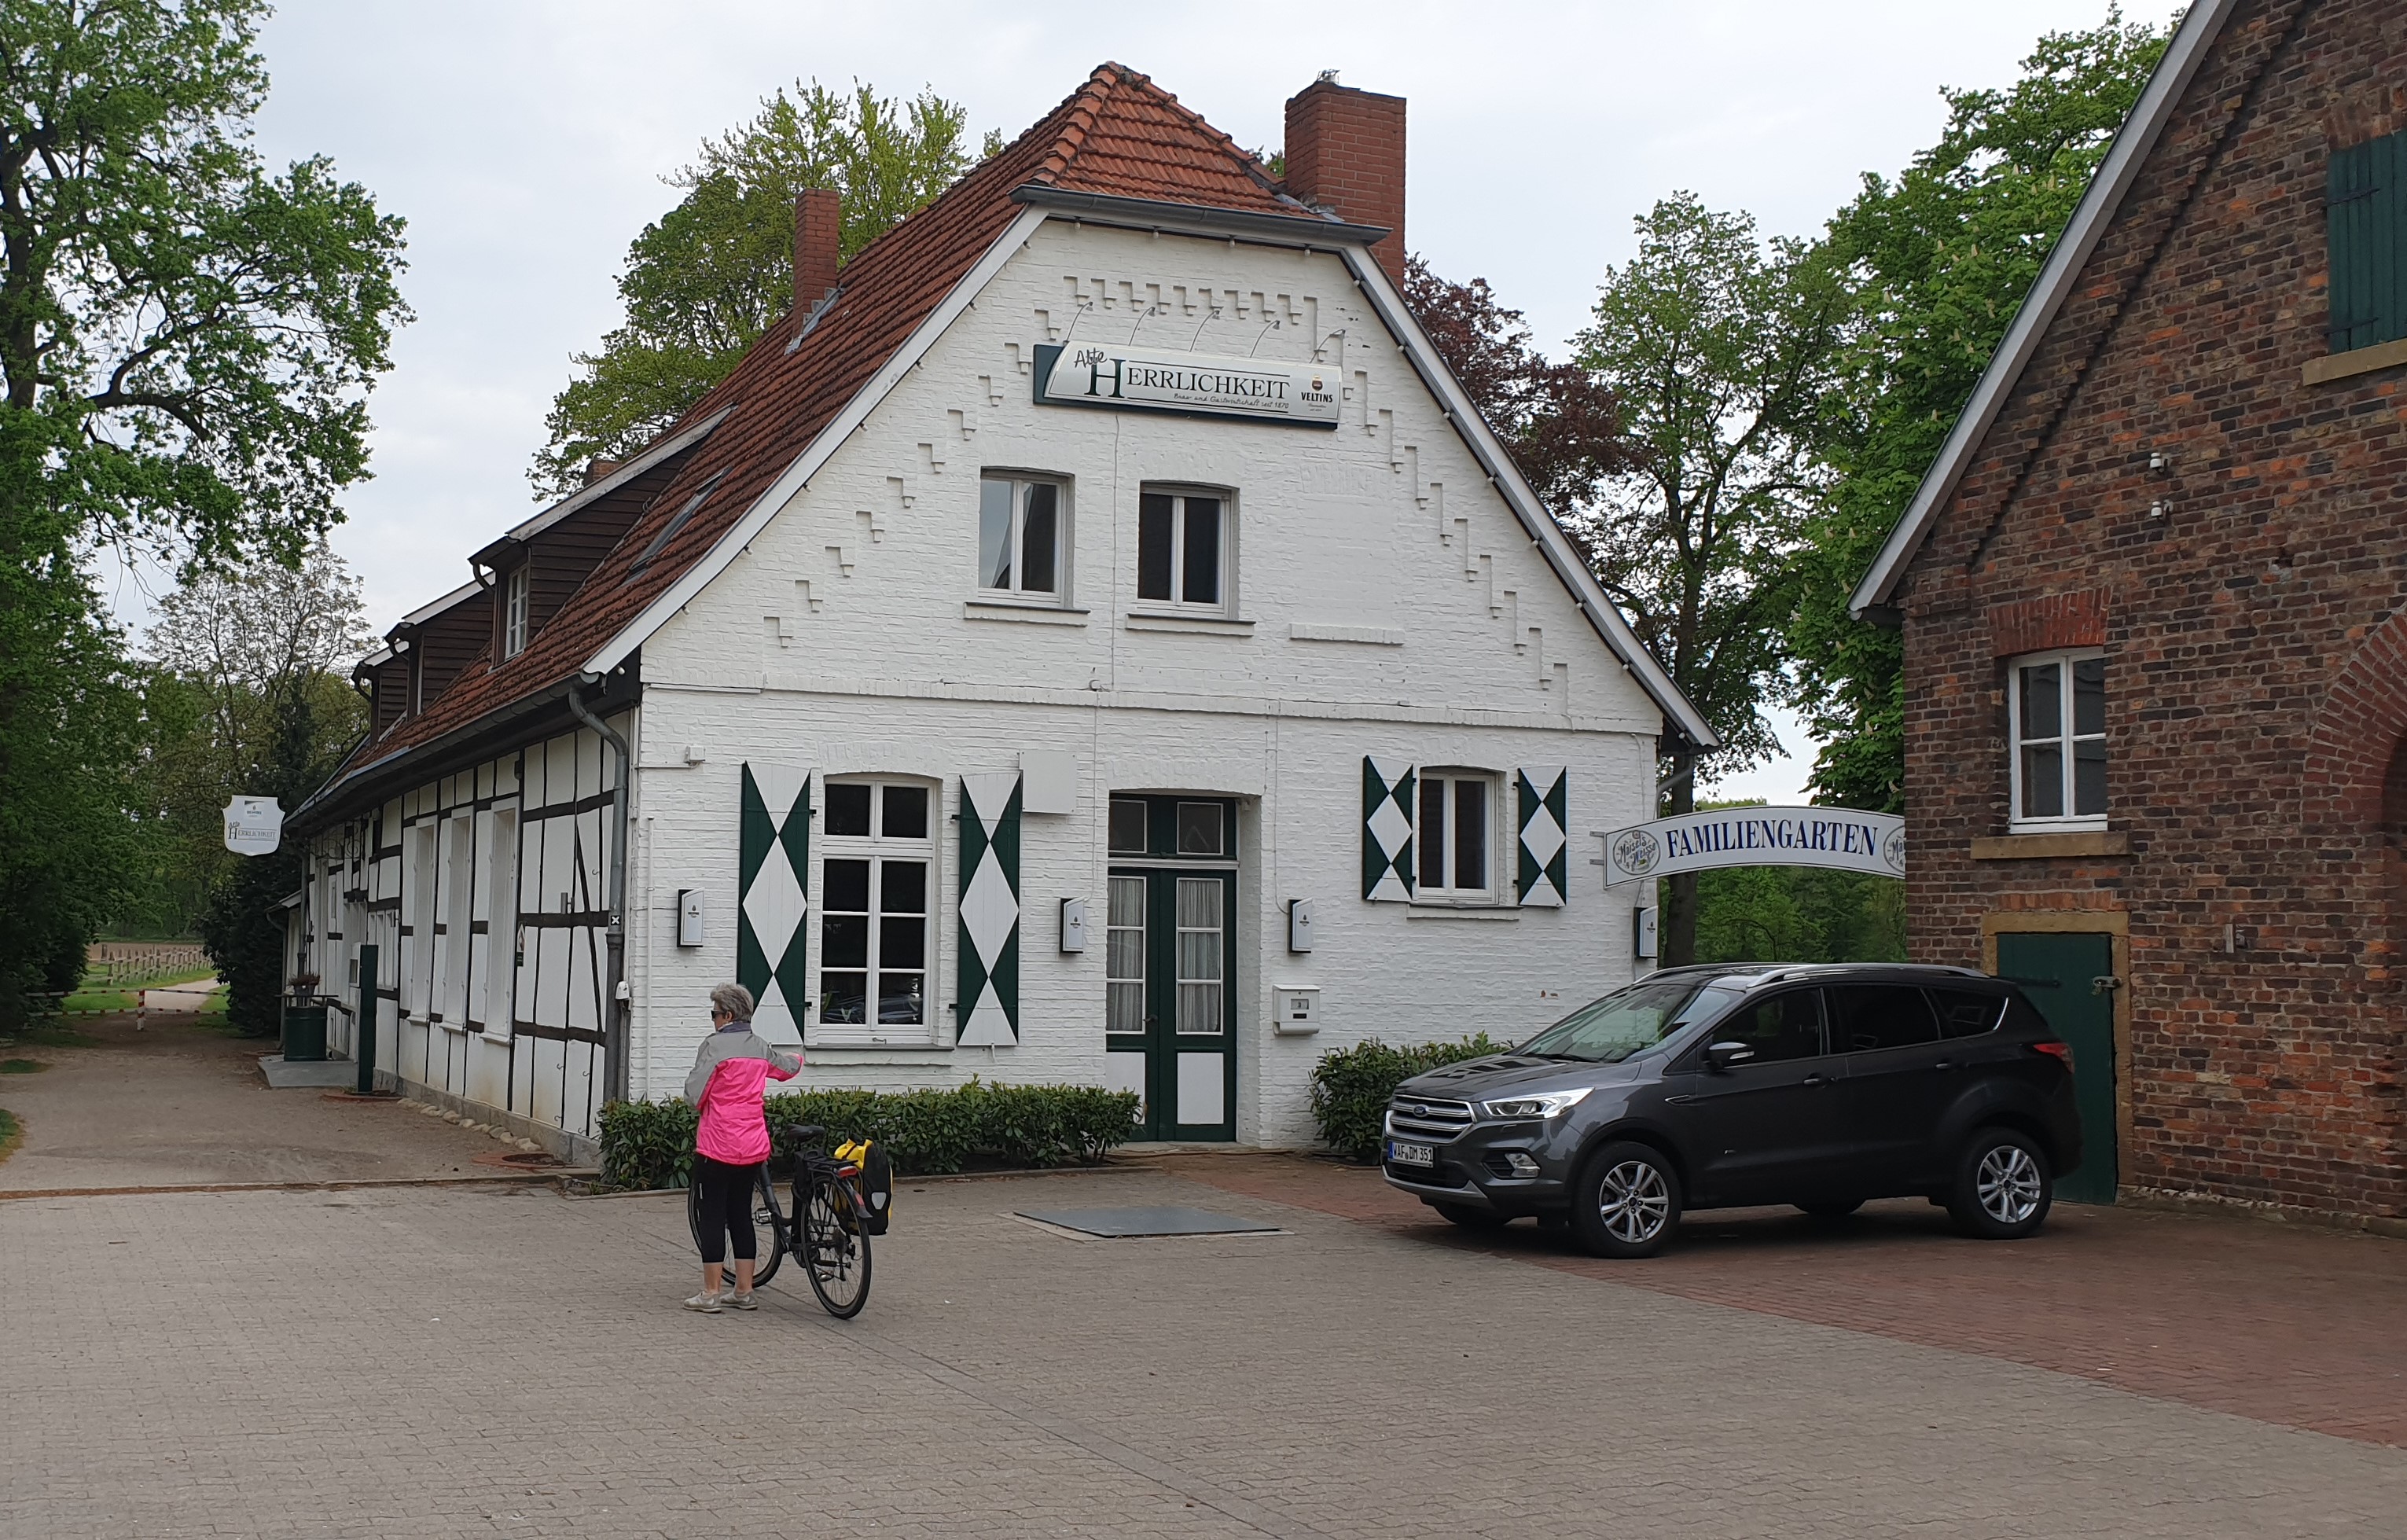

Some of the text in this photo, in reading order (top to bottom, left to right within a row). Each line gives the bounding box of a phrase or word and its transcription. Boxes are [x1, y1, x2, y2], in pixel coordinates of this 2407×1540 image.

[1074, 347, 1108, 368] Alte
[1083, 358, 1291, 399] HERRLICHKEIT
[1301, 391, 1333, 403] VELTINS
[1665, 819, 1878, 858] FAMILIENGARTEN
[1419, 1148, 1433, 1162] 351
